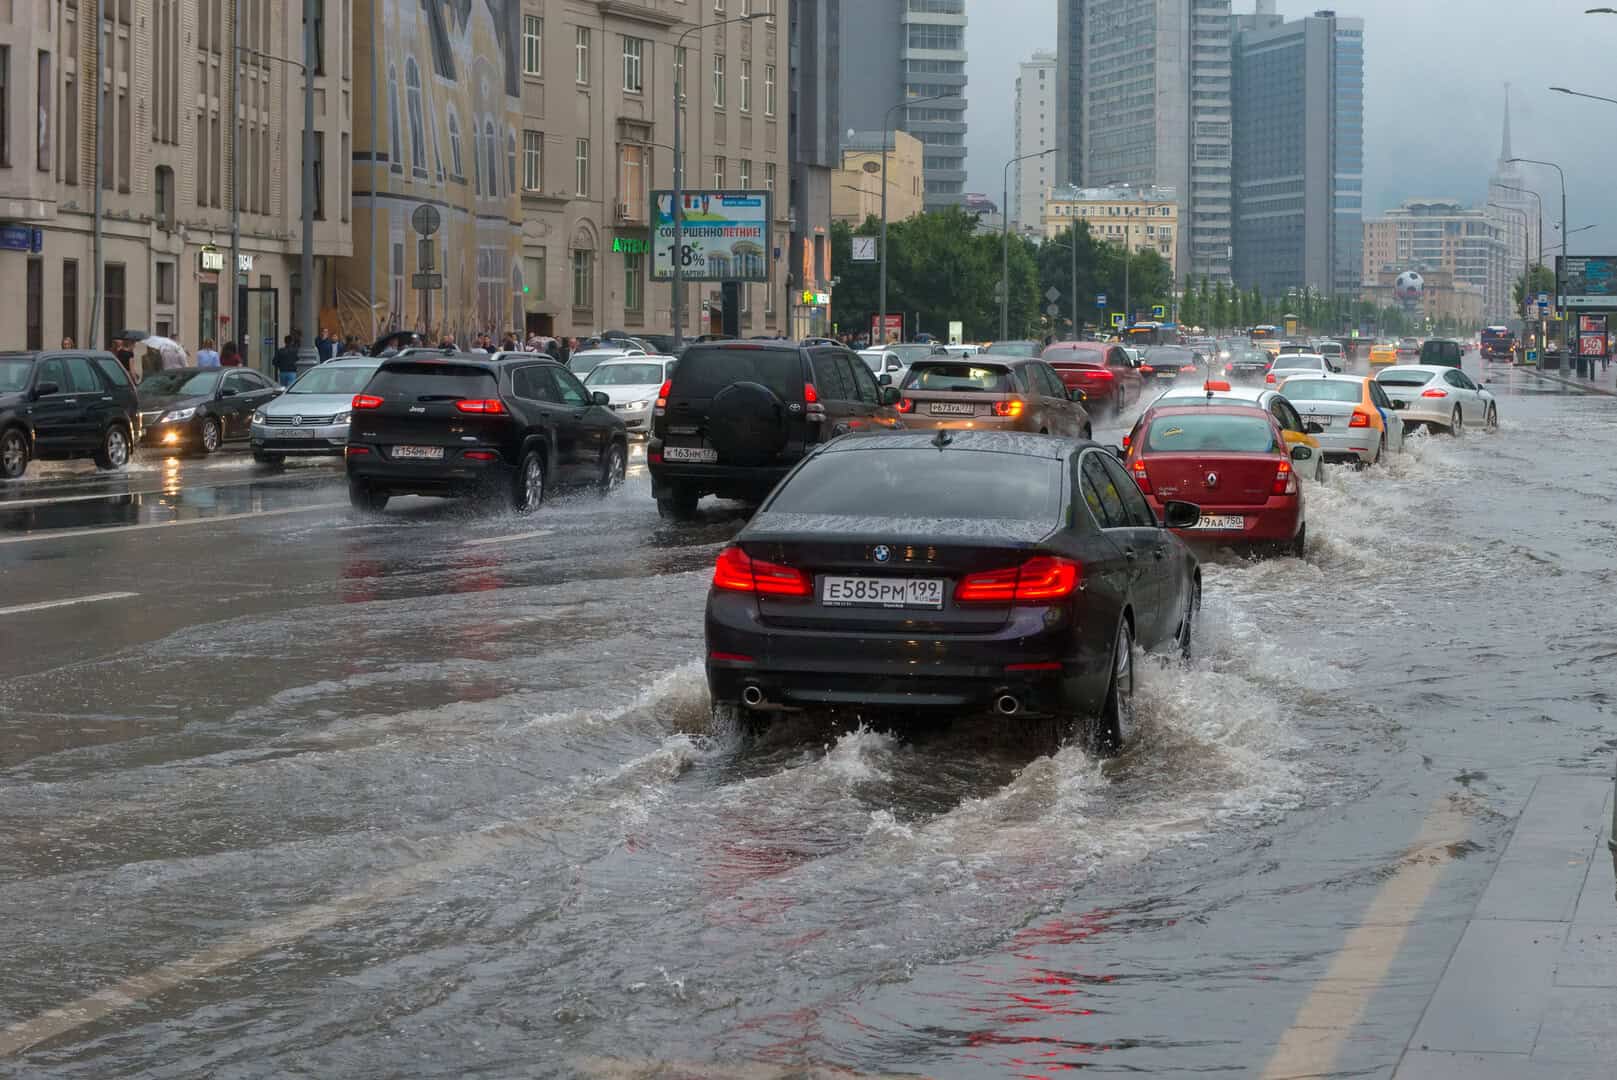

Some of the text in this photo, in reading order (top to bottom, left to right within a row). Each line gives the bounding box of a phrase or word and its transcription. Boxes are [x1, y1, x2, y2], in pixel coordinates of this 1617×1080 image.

[660, 227, 761, 238] СОВРШЕННОЛЕТНИЕ!
[658, 245, 705, 267] -18%
[830, 580, 937, 600] Е585РМ 199
